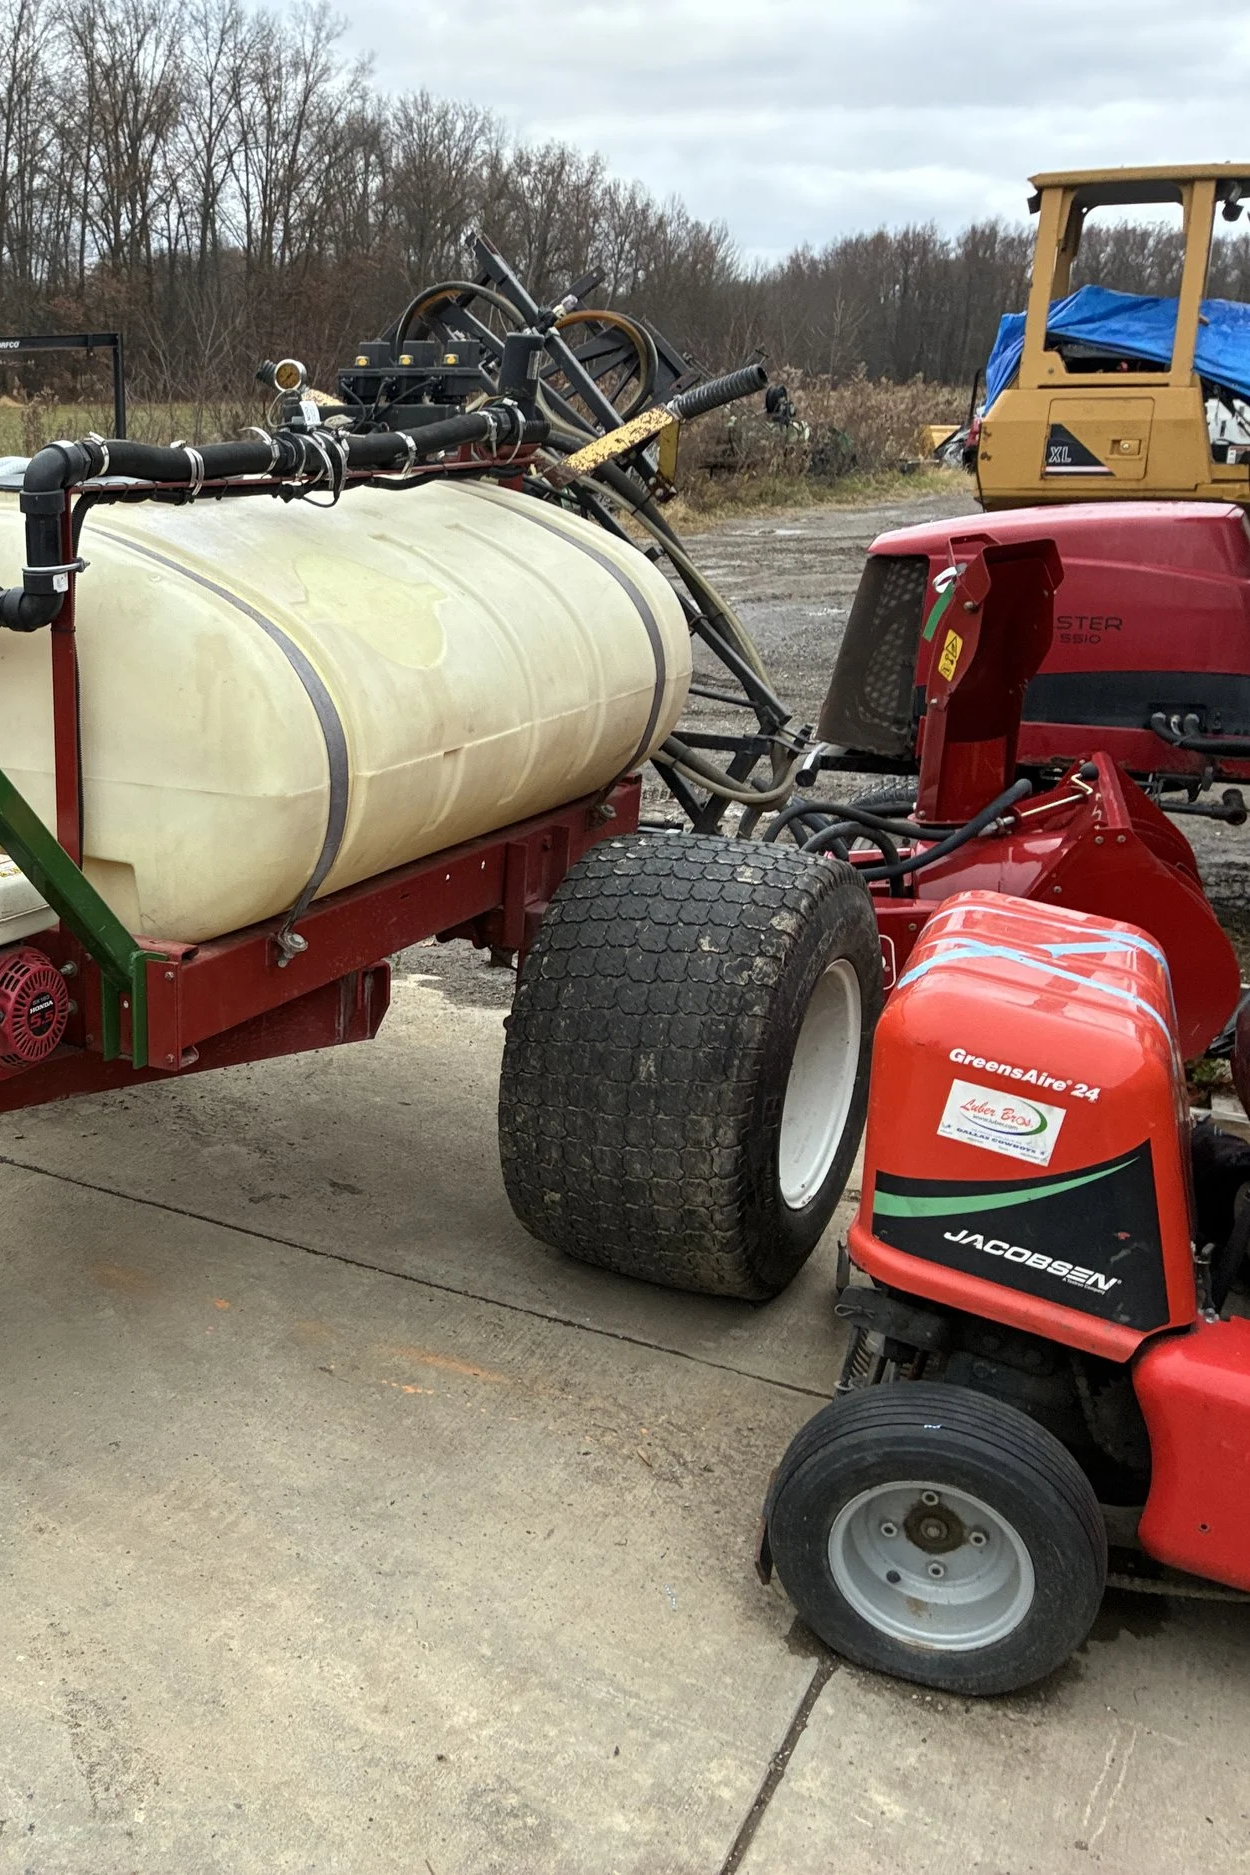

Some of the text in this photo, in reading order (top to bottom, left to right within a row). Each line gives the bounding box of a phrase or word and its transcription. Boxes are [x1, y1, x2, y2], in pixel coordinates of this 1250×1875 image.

[1049, 446, 1072, 463] XL
[1057, 615, 1123, 631] STER
[30, 1000, 54, 1014] HONDA
[1070, 1083, 1101, 1103] 24
[959, 1098, 1034, 1129] Luber Bros.
[956, 1127, 990, 1142] DALLAS
[991, 1137, 1037, 1155] COWBOYS
[943, 1229, 1118, 1291] JACOBSEN
